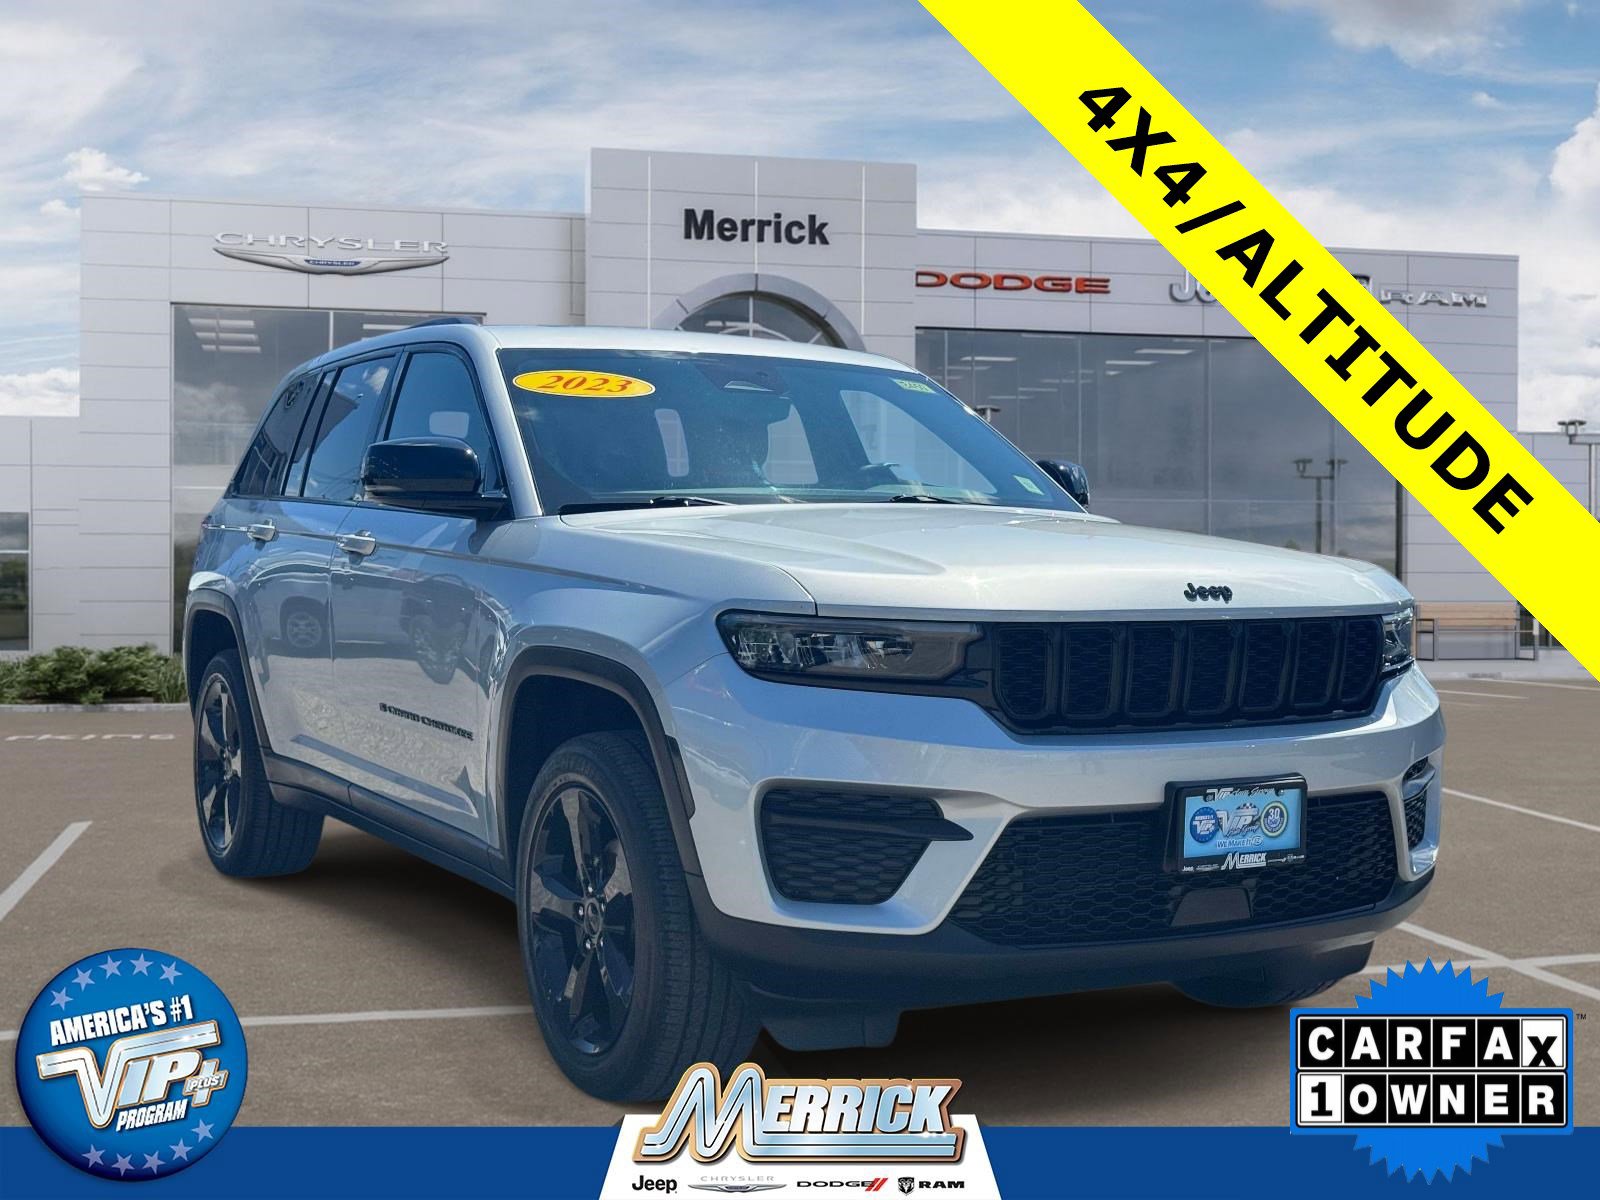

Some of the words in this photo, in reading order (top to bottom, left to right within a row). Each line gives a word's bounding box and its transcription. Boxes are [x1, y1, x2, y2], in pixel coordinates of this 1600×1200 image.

[684, 208, 830, 245] Merrick
[215, 232, 449, 253] CHRYSLER
[915, 271, 1111, 294] DODGE
[1380, 289, 1488, 308] RAM
[537, 375, 633, 393] 2023
[1184, 582, 1233, 605] Jeep
[1268, 808, 1281, 820] 30
[1220, 851, 1268, 871] MERRICK
